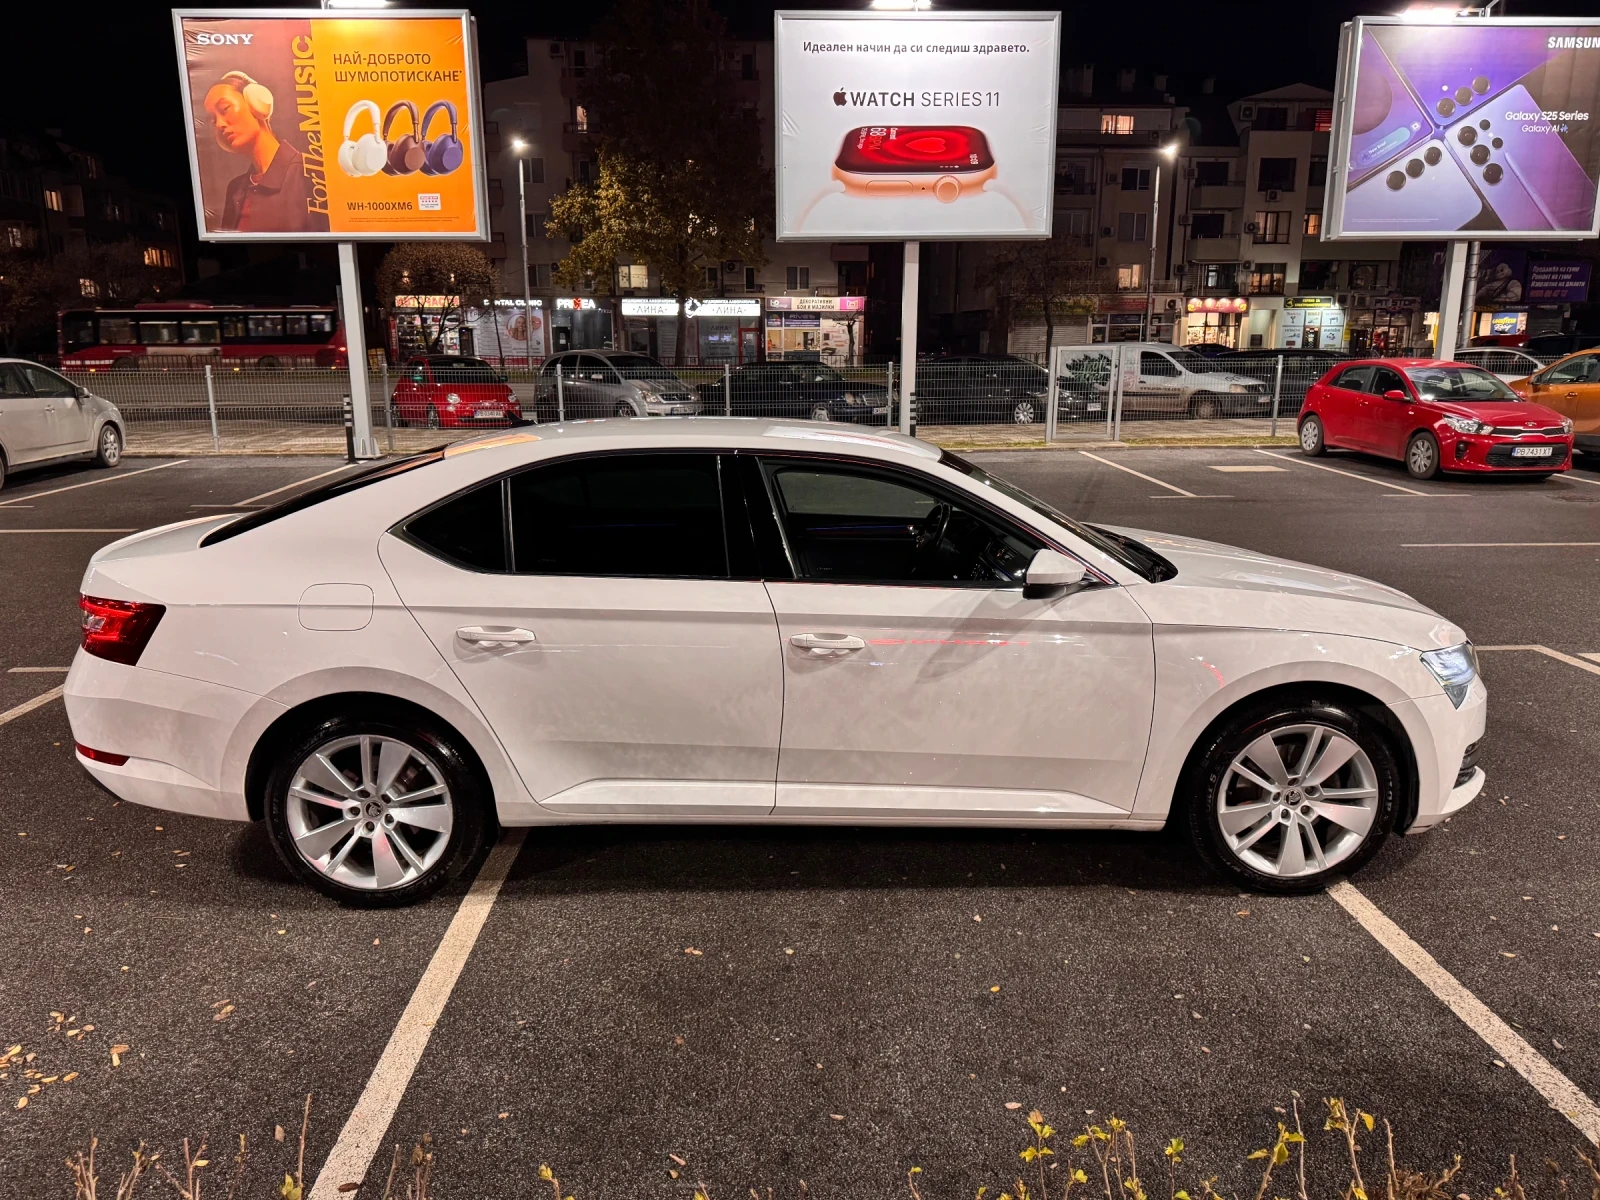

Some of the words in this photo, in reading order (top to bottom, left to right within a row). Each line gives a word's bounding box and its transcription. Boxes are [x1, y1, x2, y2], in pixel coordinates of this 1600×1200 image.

[196, 33, 254, 45] SONY
[803, 41, 853, 54] Идеален
[856, 43, 891, 53] начин
[893, 43, 908, 54] да
[910, 43, 923, 53] си
[926, 43, 970, 54] следиш
[972, 43, 1030, 55] здравето.
[333, 50, 431, 67] НАЙ-ДОБРОТО
[850, 91, 915, 107] WATCH
[921, 91, 982, 107] SERIES
[985, 91, 1000, 107] 11
[1505, 110, 1540, 123] Galaxy
[1541, 111, 1558, 121] S25
[1558, 110, 1589, 121] Series
[870, 127, 887, 137] 68
[1521, 124, 1551, 135] Galaxy
[1551, 124, 1560, 133] AI
[347, 201, 413, 212] WH-1000XM6
